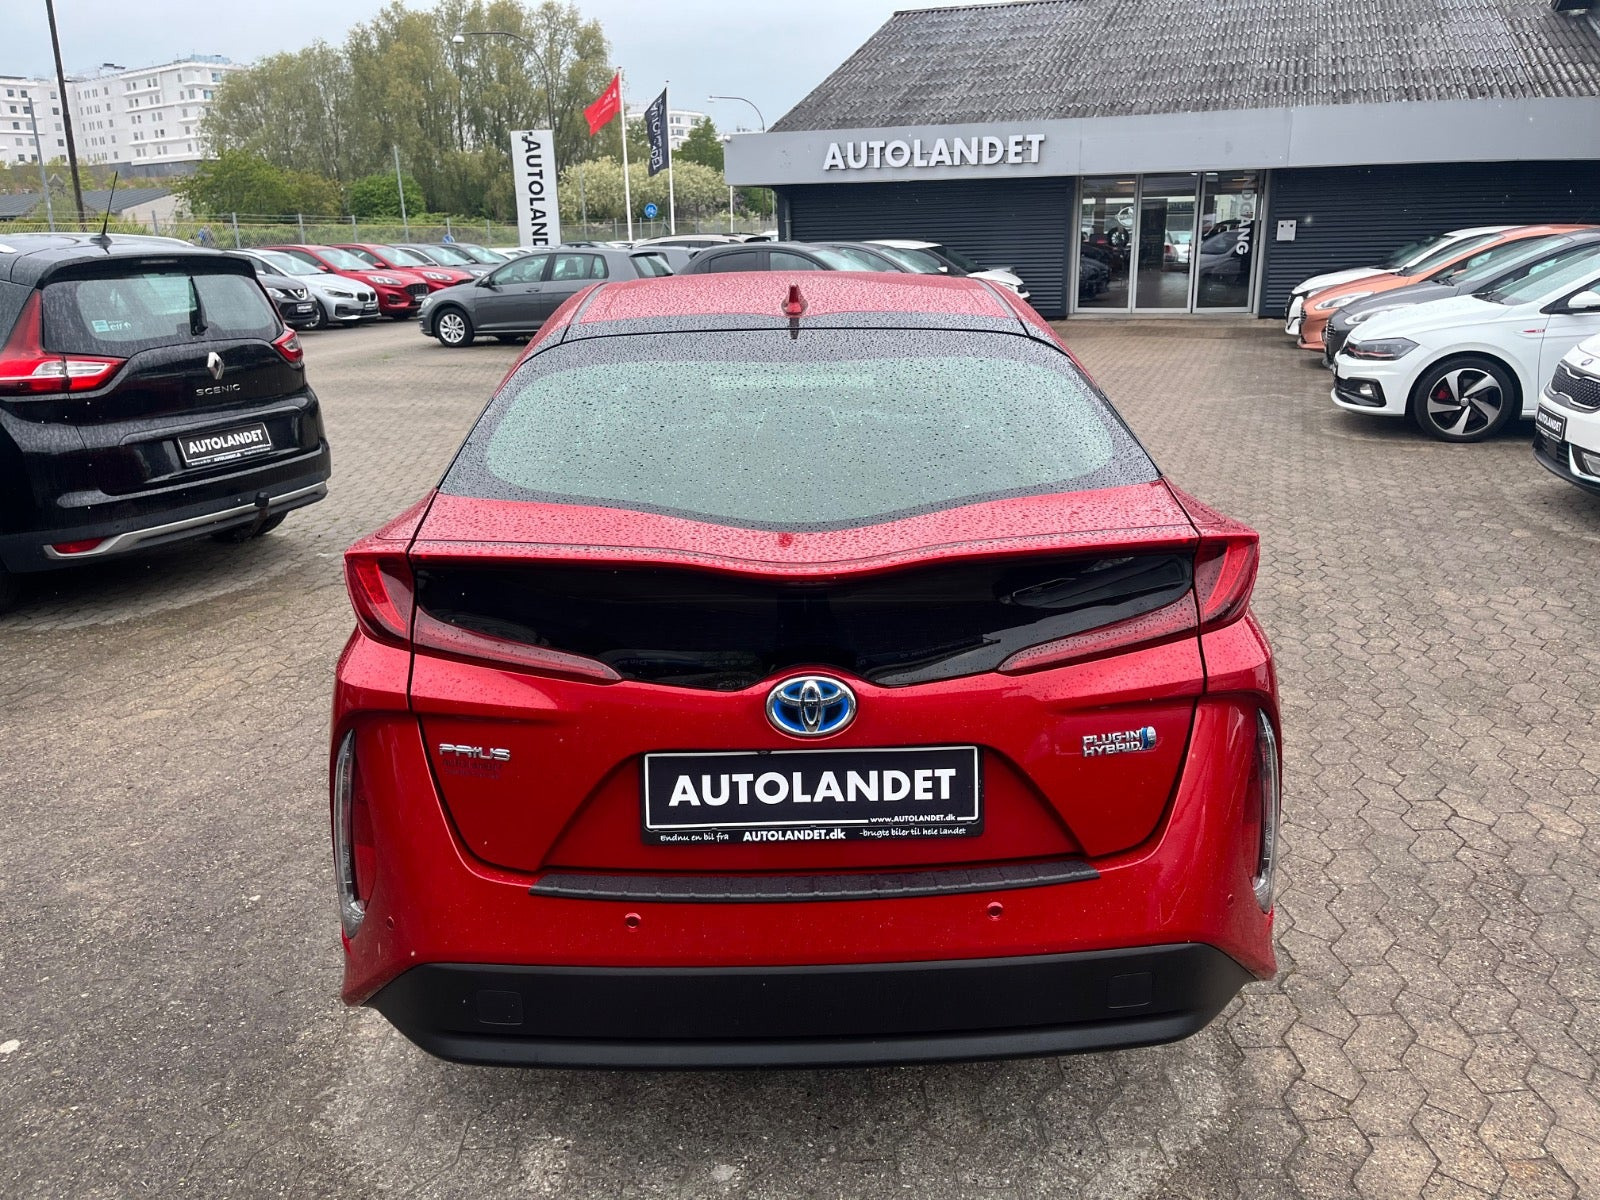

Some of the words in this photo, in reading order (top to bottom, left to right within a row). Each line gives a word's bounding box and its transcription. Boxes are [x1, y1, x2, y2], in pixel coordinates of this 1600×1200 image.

[823, 134, 1045, 170] AUTOLANDET
[196, 384, 240, 396] SCENIC
[189, 430, 263, 454] AUTOLANDET
[1082, 730, 1141, 745] PLUG-IN
[439, 743, 510, 761] PRIUS
[1082, 742, 1140, 757] HYBRID
[668, 768, 956, 807] AUTOLANDET
[870, 814, 956, 823] www.AUTOLANDET.dk
[703, 832, 714, 840] bil
[716, 832, 729, 842] fra
[743, 829, 846, 842] AUTOLANDET.dk
[891, 828, 909, 836] biler
[910, 827, 920, 835] til
[940, 827, 966, 835] landet
